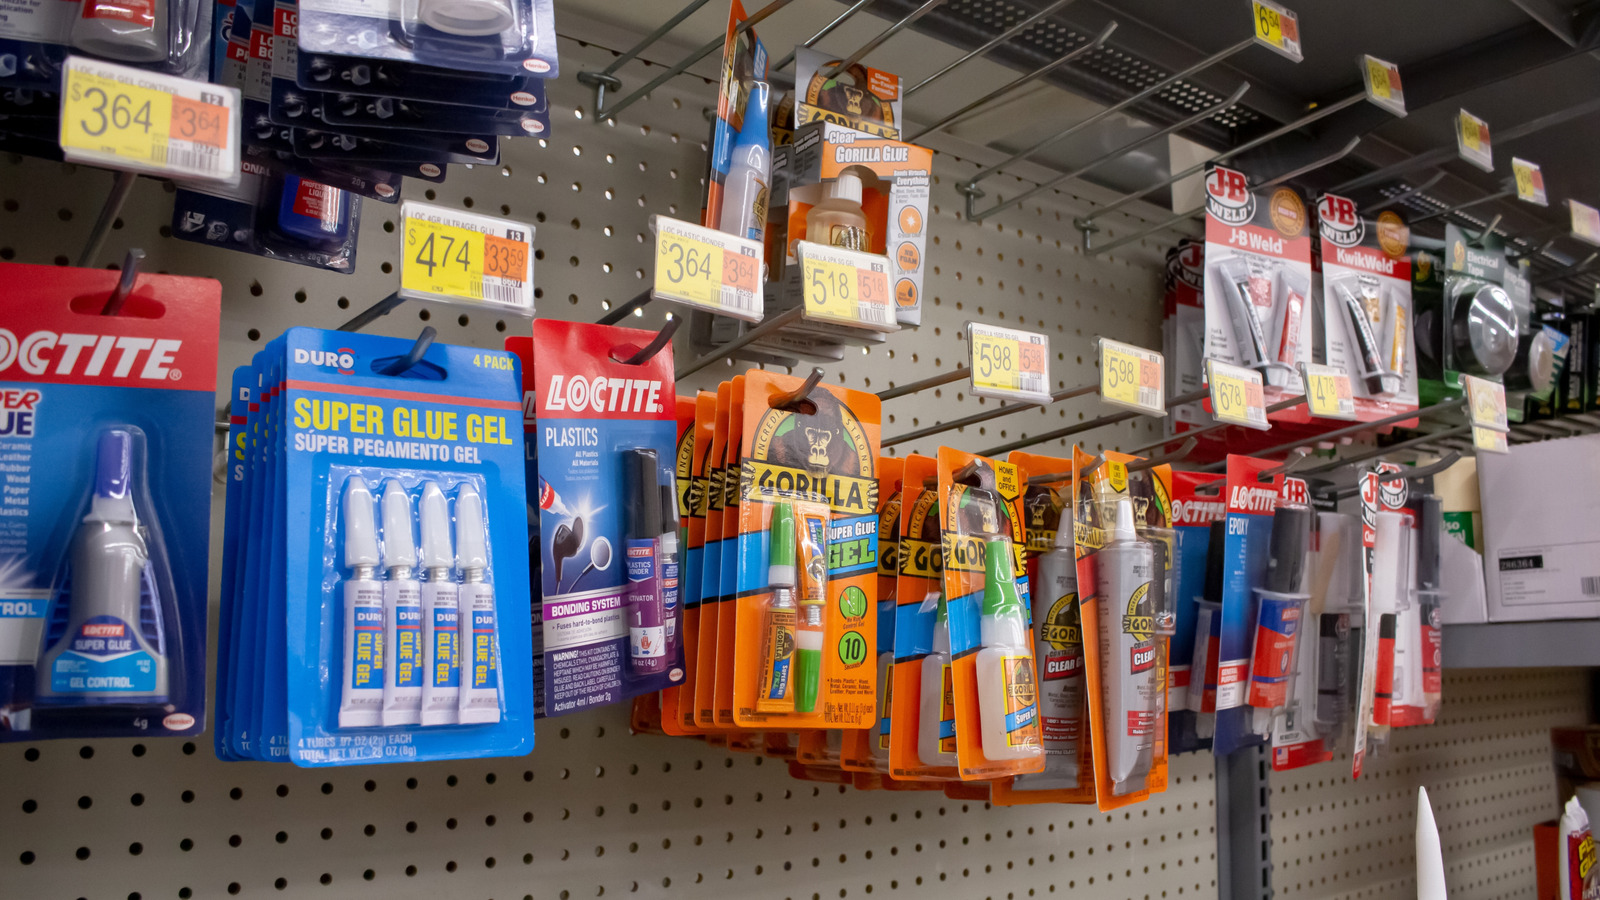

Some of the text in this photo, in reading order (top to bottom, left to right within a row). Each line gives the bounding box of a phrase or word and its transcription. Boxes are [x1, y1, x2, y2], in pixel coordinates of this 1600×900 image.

[524, 59, 550, 72] Henkel
[829, 131, 856, 144] Clear
[836, 144, 909, 163] GORILLA GLUE
[896, 175, 930, 188] Everything
[1209, 199, 1249, 221] WELD
[410, 210, 426, 221] LOC
[443, 217, 479, 233] ULTRAGEL
[480, 224, 496, 236] GLU
[1322, 222, 1358, 244] WELD
[509, 230, 522, 242] 13
[663, 225, 726, 249] LOC PLASTIC BONDER
[1249, 231, 1284, 255] Weld
[408, 228, 471, 278] $474
[660, 239, 712, 284] $364
[805, 251, 827, 262] GORILLA
[1336, 248, 1395, 275] KwikWeld
[1466, 250, 1500, 269] Electrical
[1467, 263, 1485, 277] Tape
[805, 265, 850, 306] $518
[294, 348, 515, 371] DURO 4 PACK
[974, 341, 1012, 378] $598
[545, 374, 663, 413] LOCTITE
[294, 397, 513, 446] SUPER GLUE GEL
[294, 428, 482, 465] SÚPER PEGAMENTO GEL
[545, 427, 599, 447] PLASTICS
[6, 474, 30, 484] Wood
[998, 465, 1015, 477] HOME
[1002, 475, 1012, 484] and
[3, 485, 30, 496] Paper
[758, 467, 866, 511] GORILLA
[998, 481, 1017, 493] OFFICE
[4, 496, 29, 506] Metal
[1229, 485, 1279, 513] LOCTITE
[855, 520, 876, 535] GLUE
[1228, 517, 1250, 536] EPOXY
[829, 538, 876, 570] GEL
[551, 596, 621, 618] BONDING SYSTEM
[556, 622, 572, 631] Fuses
[572, 616, 604, 629] hard-to-bond
[636, 611, 643, 626] 1
[75, 639, 132, 651] SUPER GLUE
[775, 630, 786, 660] GORILLA
[843, 638, 861, 661] 10
[356, 632, 372, 687] GLUE GEL
[399, 631, 414, 685] GLUE GEL
[436, 632, 451, 685] GLUE GEL
[475, 634, 489, 687] GLUE GEL
[1047, 658, 1076, 674] CLEAR
[69, 676, 134, 689] GEL CONTROL
[1013, 683, 1035, 696] GORILL
[553, 700, 576, 713] Activator
[588, 694, 606, 705] Bonder
[604, 691, 612, 702] 2g
[133, 717, 149, 730] 4g
[298, 737, 305, 748] 4
[306, 736, 336, 748] TUBES
[353, 735, 368, 747] OZ
[368, 734, 387, 749] (2g)
[389, 733, 413, 745] EACH
[299, 749, 327, 760] TOTAL
[331, 748, 347, 759] NET
[385, 746, 399, 757] OZ
